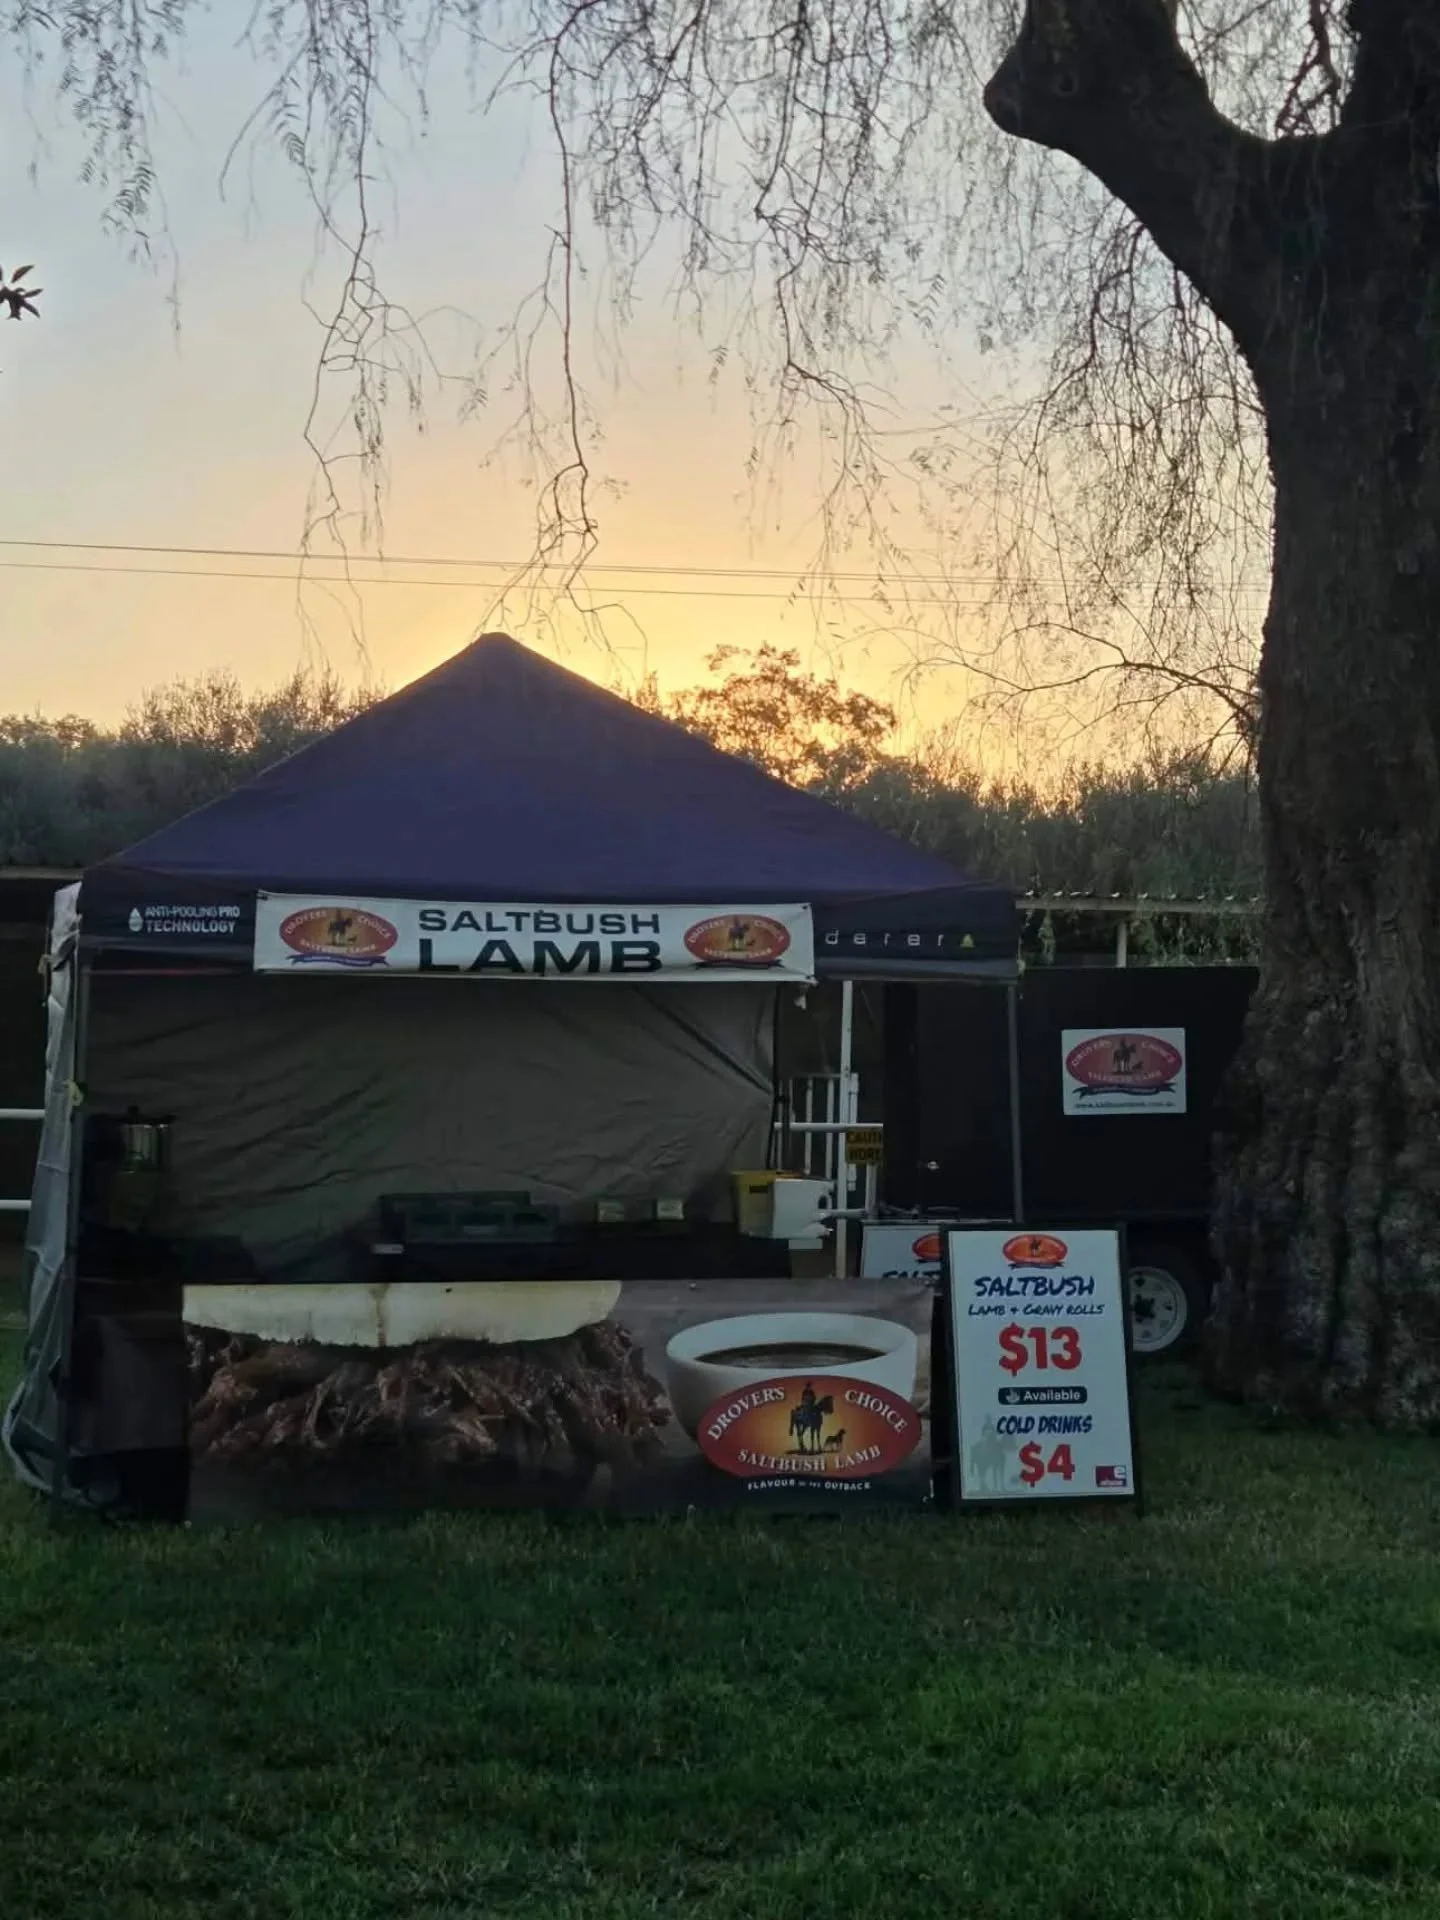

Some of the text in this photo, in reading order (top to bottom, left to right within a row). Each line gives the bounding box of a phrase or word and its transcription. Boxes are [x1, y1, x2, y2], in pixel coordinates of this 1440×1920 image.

[145, 905, 241, 918] ANTI-POOLING PRO
[419, 909, 660, 935] SALTBUSH
[146, 919, 236, 934] TECHNOLOGY
[418, 938, 662, 974] LAMB
[974, 1276, 1096, 1297] SALTBUSH
[968, 1303, 1006, 1317] LAMB
[1023, 1303, 1064, 1316] GRAVY
[1065, 1303, 1106, 1316] ROLLS
[998, 1321, 1083, 1378] $13
[1023, 1388, 1081, 1402] Available
[707, 1386, 909, 1441] DROVERS CHOICE
[996, 1415, 1094, 1436] COLD DRINKS
[737, 1444, 882, 1472] SALTBUSH LAMB
[1018, 1441, 1076, 1488] $4
[747, 1479, 796, 1491] FLAVOUR
[824, 1480, 873, 1492] OUTBACK
